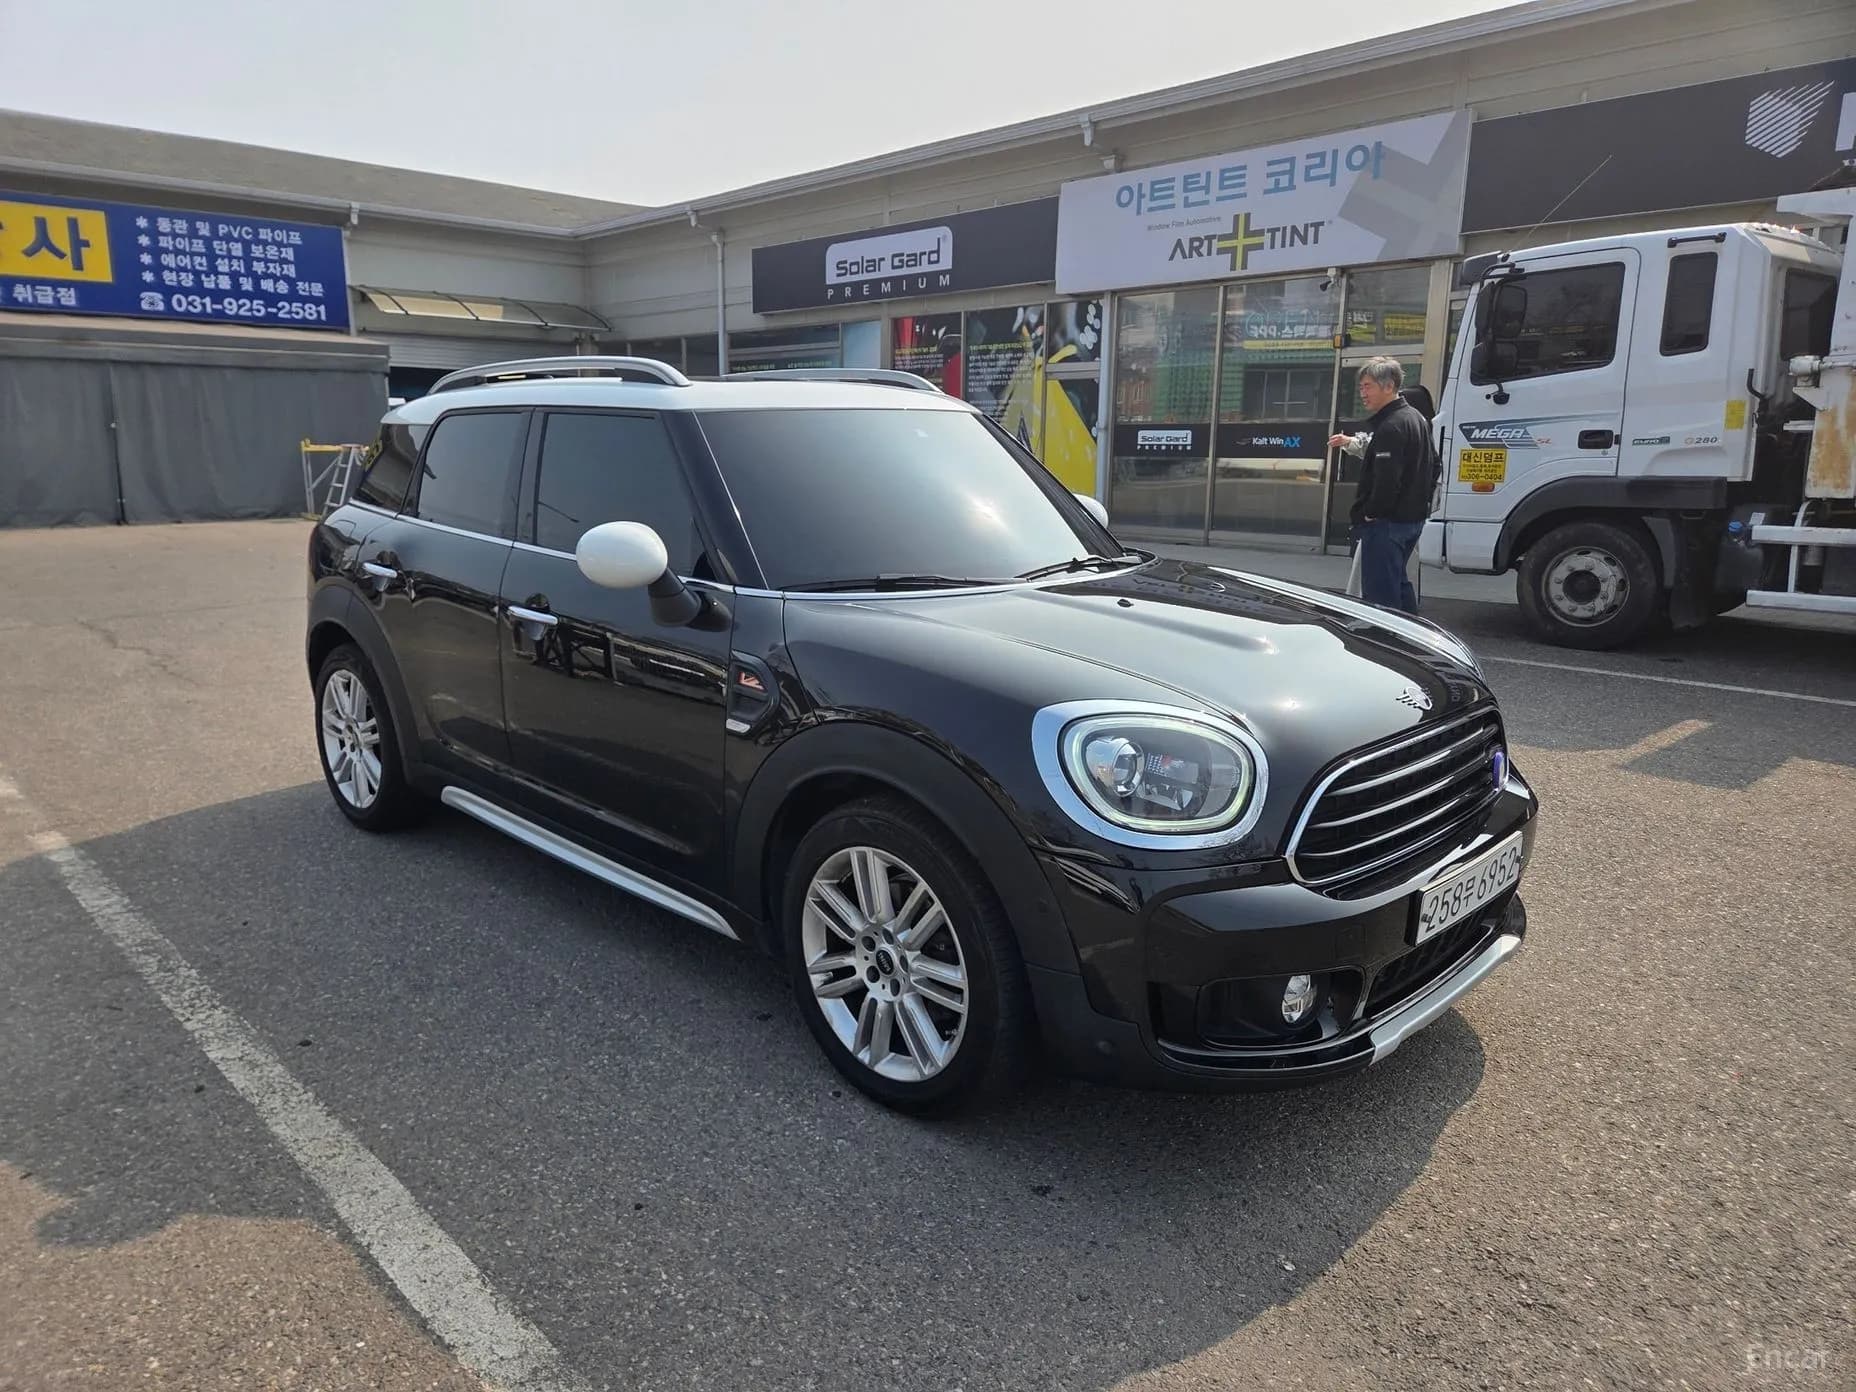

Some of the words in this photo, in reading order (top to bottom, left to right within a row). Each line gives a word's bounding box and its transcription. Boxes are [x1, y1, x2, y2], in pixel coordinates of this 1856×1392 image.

[1115, 165, 1247, 216] 아트틴트
[1263, 141, 1383, 197] 코리아
[157, 217, 188, 234] 동관
[196, 221, 211, 236] 및
[218, 224, 252, 240] PVC
[258, 228, 302, 245] 파이프
[1171, 219, 1184, 228] Film
[0, 217, 90, 272] 사
[158, 236, 206, 252] 파이프
[213, 240, 243, 257] 단열
[251, 244, 294, 262] 보온재
[1168, 234, 1217, 261] ART
[1266, 221, 1325, 250] TINT
[161, 253, 207, 270] 에어컨
[215, 257, 244, 274] 설치
[252, 261, 296, 278] 부자재
[836, 256, 886, 278] Solar
[891, 237, 941, 271] Gard
[13, 283, 76, 306] 취급점
[162, 269, 194, 287] 현장
[201, 273, 231, 290] 납품
[239, 276, 253, 292] 및
[261, 279, 289, 295] 배송
[296, 281, 325, 297] 전문
[827, 274, 950, 300] PREMIUM
[171, 294, 326, 321] 031-925-2581
[1141, 435, 1164, 443] Solar
[1166, 432, 1188, 443] Gard
[1471, 428, 1524, 439] MEGA
[1695, 436, 1718, 444] 280
[1462, 452, 1504, 463] 대신덤프
